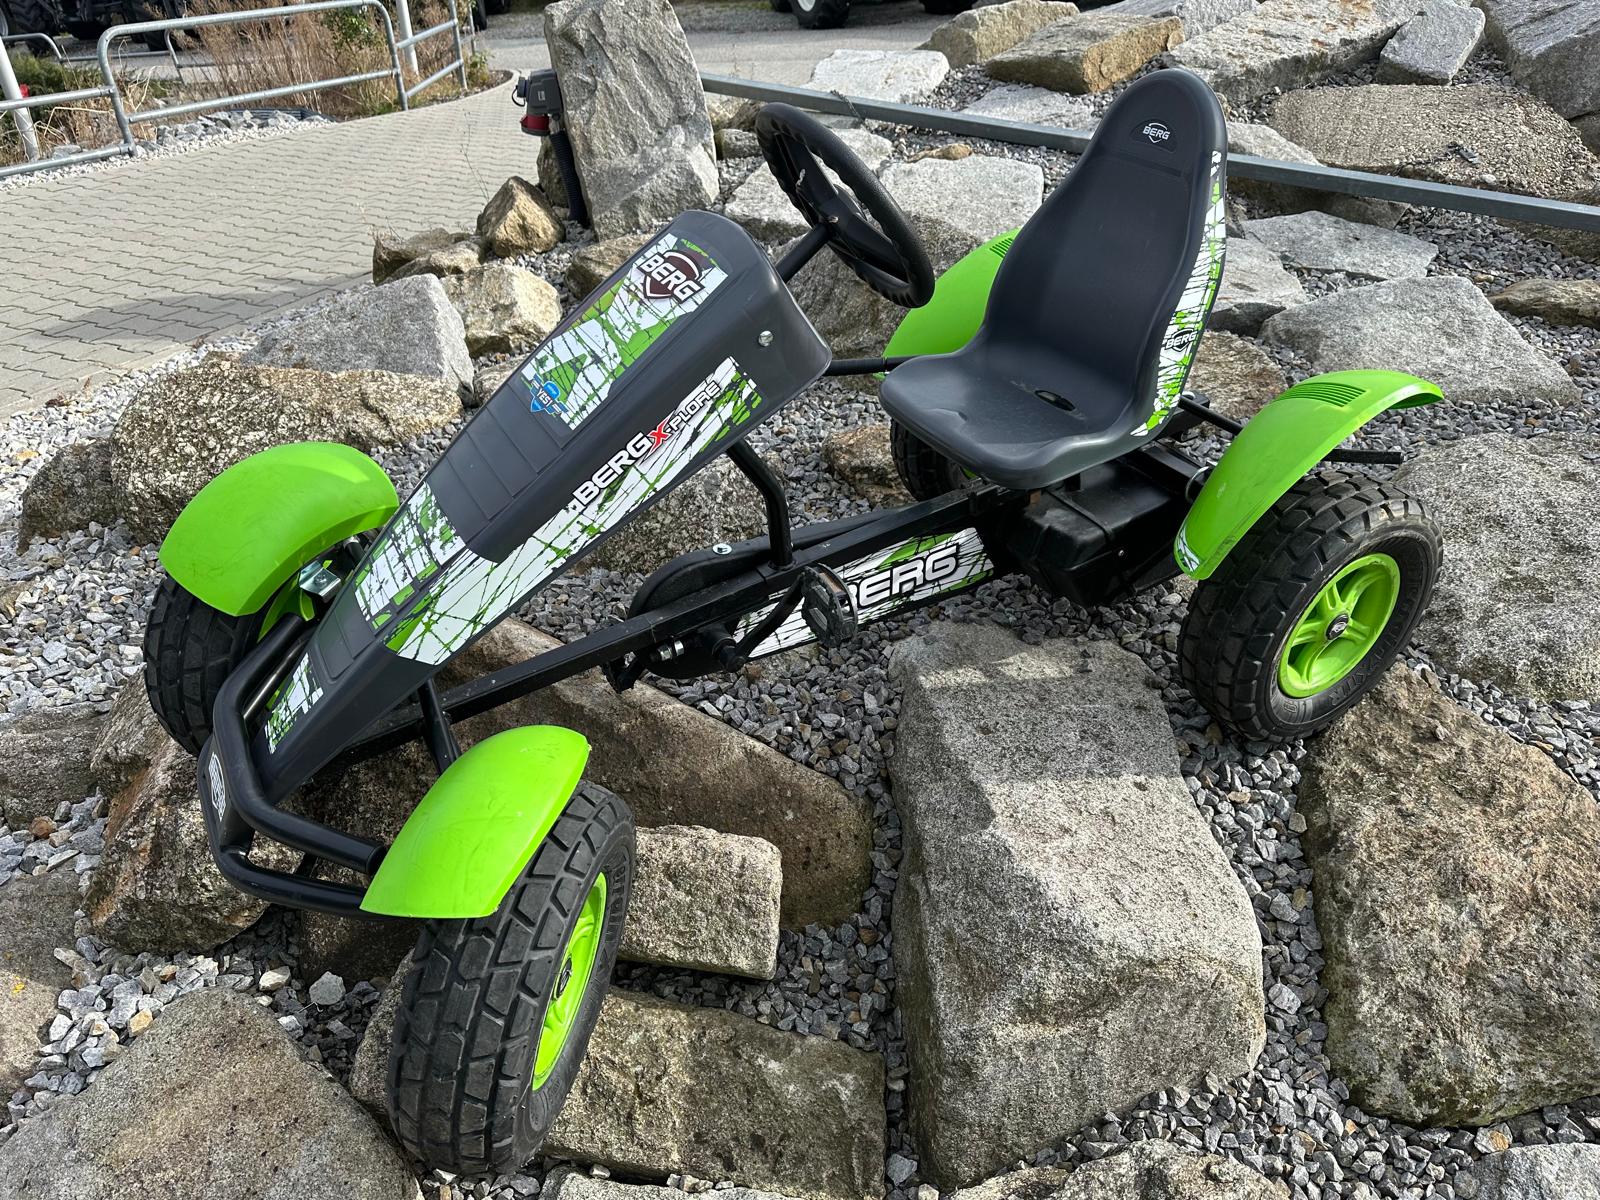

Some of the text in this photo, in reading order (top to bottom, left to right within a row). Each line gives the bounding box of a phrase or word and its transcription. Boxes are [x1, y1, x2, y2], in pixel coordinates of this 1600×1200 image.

[1142, 126, 1171, 141] BERG
[641, 256, 702, 301] BERG
[1166, 331, 1198, 350] BERG
[573, 382, 721, 505] BERG X-PLORE
